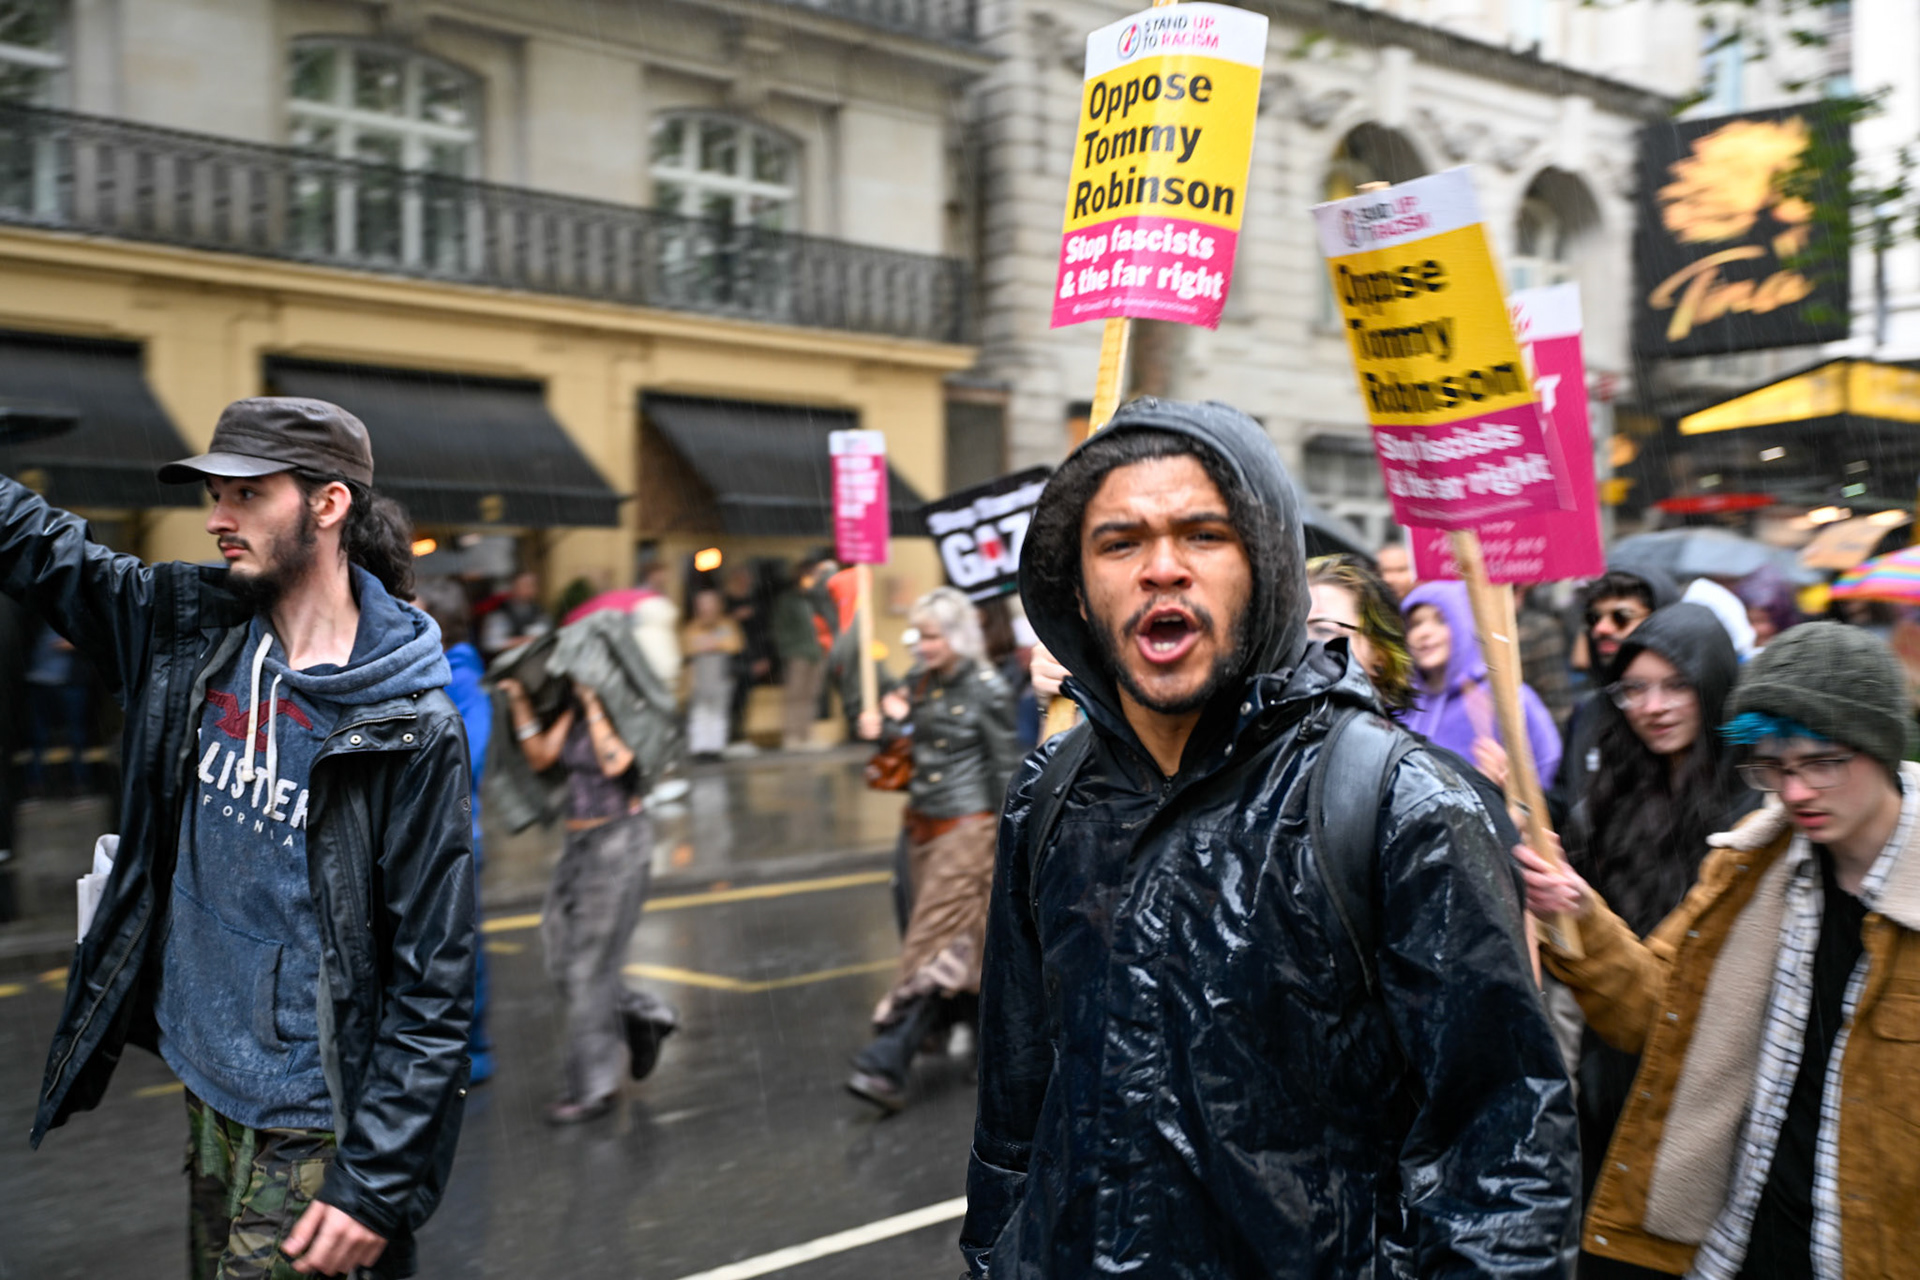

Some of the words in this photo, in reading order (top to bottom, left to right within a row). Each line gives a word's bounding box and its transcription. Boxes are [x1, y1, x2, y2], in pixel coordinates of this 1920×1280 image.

[1143, 34, 1158, 51] TO
[1161, 32, 1220, 49] RACISM
[1145, 15, 1188, 33] STAND
[1193, 15, 1215, 29] UP
[1089, 73, 1213, 124] Oppose
[1083, 124, 1203, 170] Tommy
[1072, 167, 1236, 220] Robinson
[1065, 234, 1108, 264] Stop
[1110, 223, 1215, 260] fascists
[1059, 270, 1076, 298] &
[1077, 265, 1110, 295] the
[1110, 258, 1153, 288] far
[1156, 261, 1225, 301] right
[941, 506, 1038, 588] GAZ
[197, 728, 309, 832] LISTER
[203, 794, 294, 848] FORNIA
